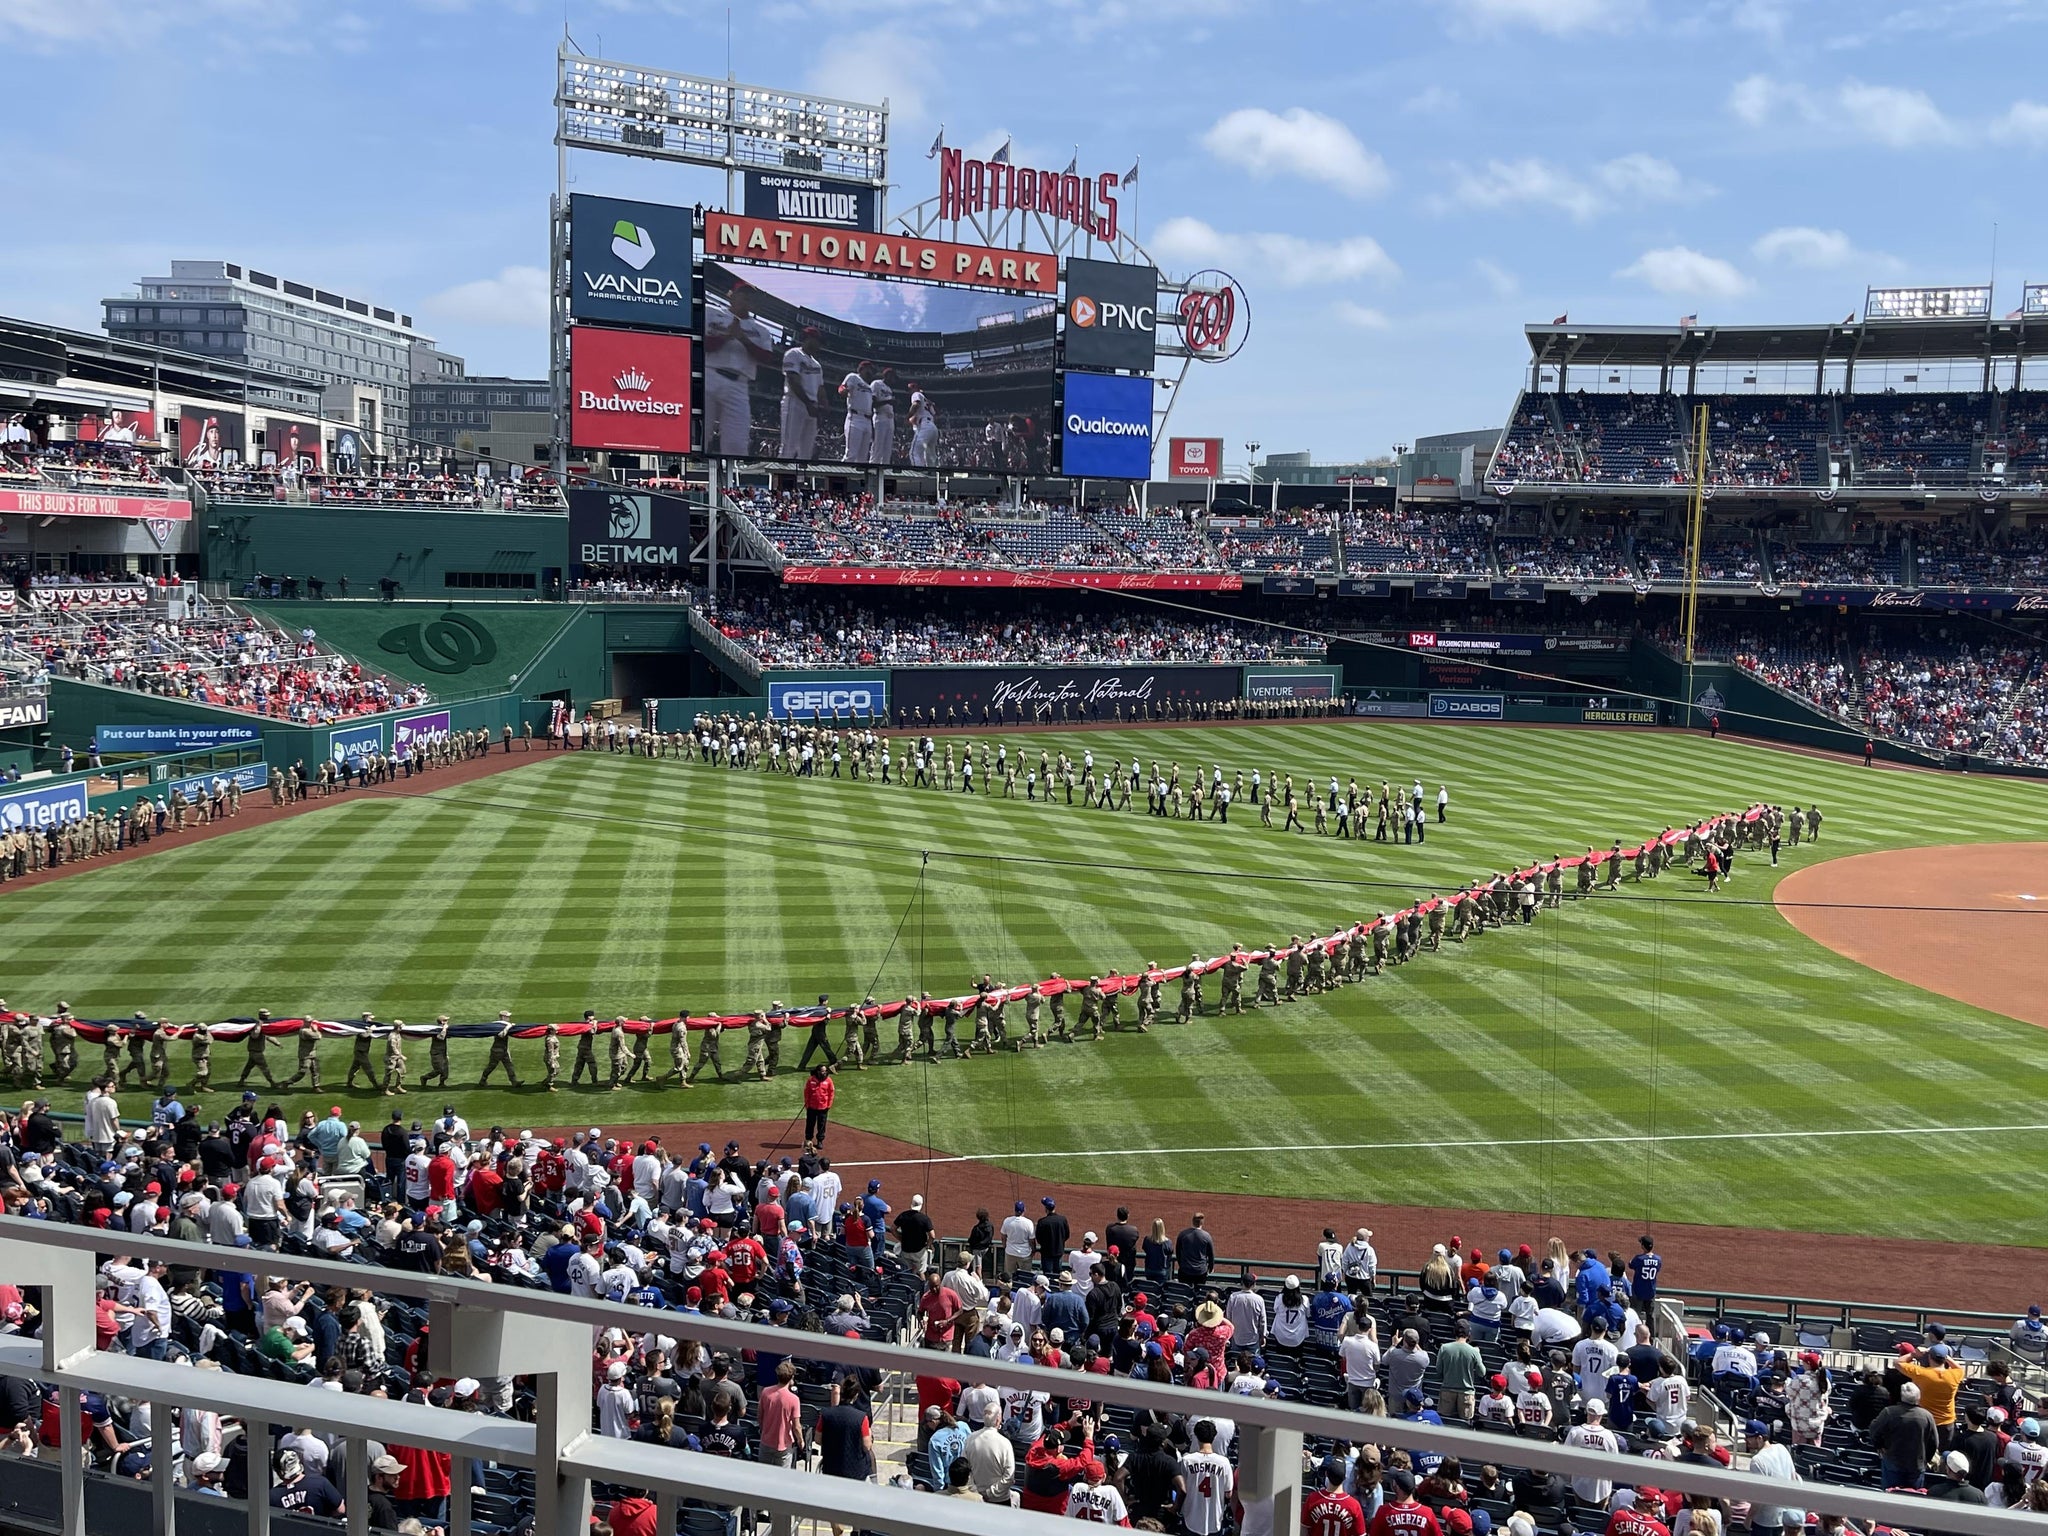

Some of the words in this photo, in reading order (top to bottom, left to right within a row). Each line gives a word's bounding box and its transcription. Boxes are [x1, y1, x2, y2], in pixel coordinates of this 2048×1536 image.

[760, 176, 791, 188] SHOW
[792, 179, 820, 190] SOME
[940, 147, 1118, 242] NATIONALS
[777, 189, 858, 220] NATITUDE
[720, 223, 936, 270] NATIONALS
[956, 253, 1040, 283] PARK
[583, 271, 683, 299] VANDA
[588, 291, 664, 305] PHARMACEUTICALS
[1100, 302, 1153, 332] PNC
[580, 390, 684, 415] Budweiser
[1067, 414, 1149, 437] Qualcomm
[1179, 466, 1209, 475] TOYOTA
[17, 493, 42, 510] THIS
[44, 497, 75, 512] BUD'S
[77, 499, 97, 513] FOR
[99, 500, 121, 514] YOU.
[581, 543, 678, 565] BETMGM
[1868, 592, 1926, 608] Nationals
[1412, 633, 1434, 646] 12:54
[1437, 640, 1471, 648] WASHINGTON
[1429, 666, 1469, 674] powered
[1471, 666, 1482, 675] by
[1439, 675, 1473, 684] Verizon
[992, 676, 1081, 715] Washington
[1084, 676, 1154, 703] Nationals
[1253, 687, 1293, 696] VENTURE
[782, 690, 871, 711] GEICO
[1450, 702, 1500, 712] DABOS
[0, 704, 41, 725] FAN
[1585, 711, 1625, 721] HERCULES
[1628, 713, 1654, 722] FENCE
[103, 730, 124, 739] Put
[148, 729, 177, 739] bank
[179, 729, 190, 738] in
[191, 730, 219, 740] your
[220, 728, 252, 738] office
[344, 739, 379, 756] VANDA
[25, 799, 81, 826] Terra
[232, 1131, 240, 1144] 6
[546, 1165, 557, 1176] 34
[533, 1173, 545, 1183] 34
[822, 1186, 834, 1199] 50
[734, 1252, 750, 1265] 20
[1326, 1249, 1337, 1262] 17
[570, 1268, 582, 1285] 42
[1641, 1267, 1657, 1280] 50
[1286, 1310, 1299, 1324] 17
[1318, 1304, 1344, 1318] Dodgers
[1588, 1357, 1601, 1373] 17
[1731, 1361, 1740, 1372] 5
[641, 1383, 654, 1393] BELL
[1555, 1387, 1564, 1401] 5
[1619, 1389, 1630, 1403] 17
[1670, 1391, 1679, 1404] 5
[1525, 1408, 1541, 1422] 28
[1584, 1435, 1604, 1446] SOTO
[1198, 1477, 1211, 1498] 4
[280, 1490, 307, 1508] GRAY
[1322, 1518, 1341, 1536] 11
[1386, 1513, 1428, 1529] SCHERZER
